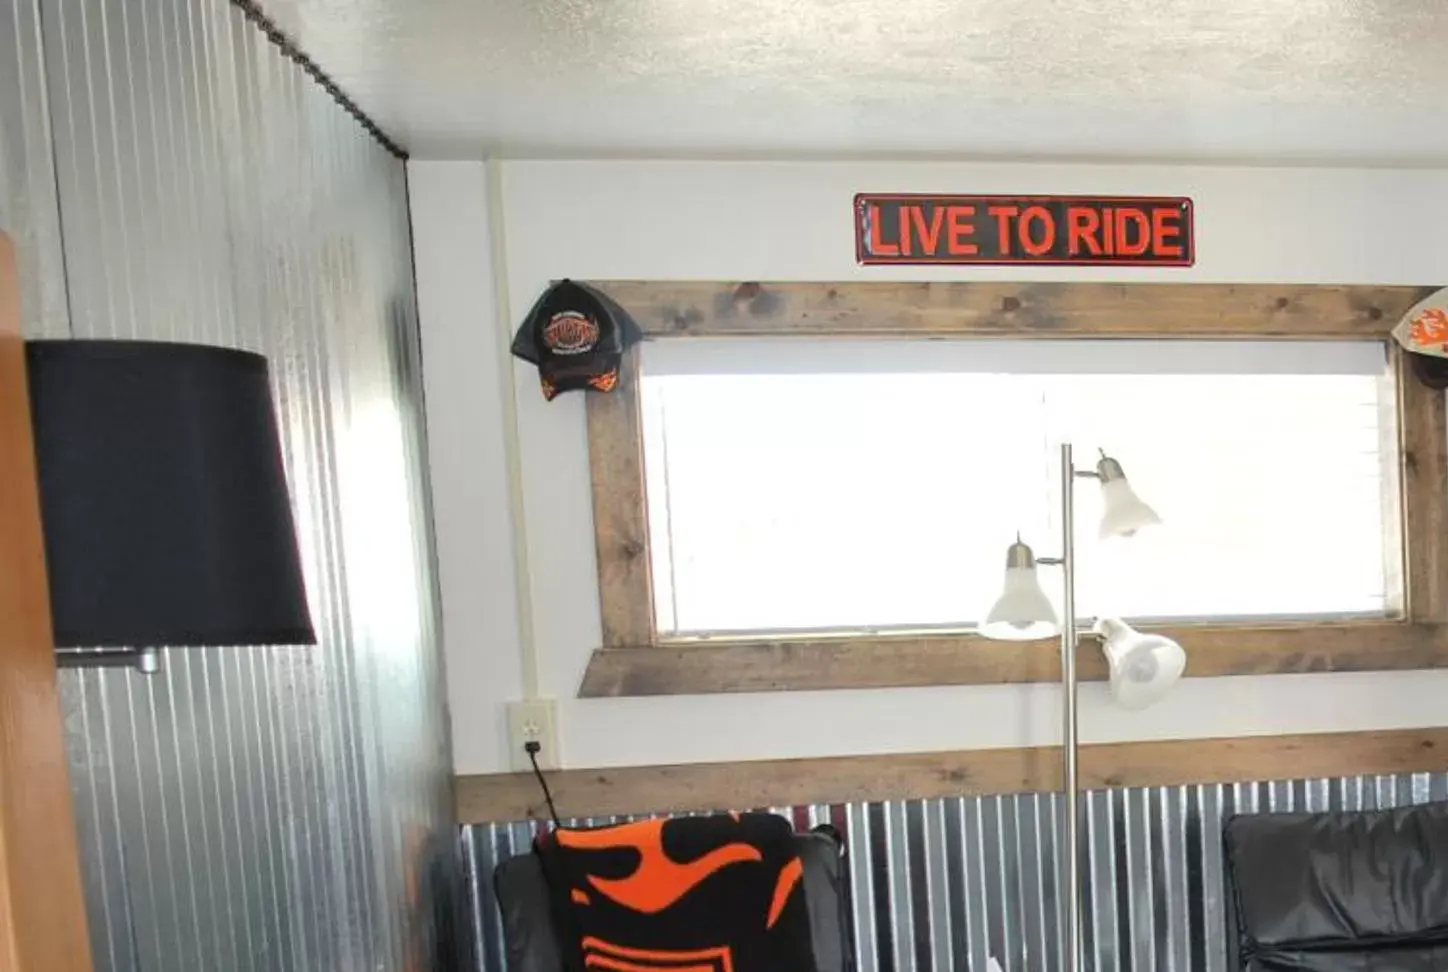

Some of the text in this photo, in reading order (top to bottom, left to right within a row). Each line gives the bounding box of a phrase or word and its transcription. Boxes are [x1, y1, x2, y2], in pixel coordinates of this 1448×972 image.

[869, 205, 1184, 258] LIVE TO RIDE
